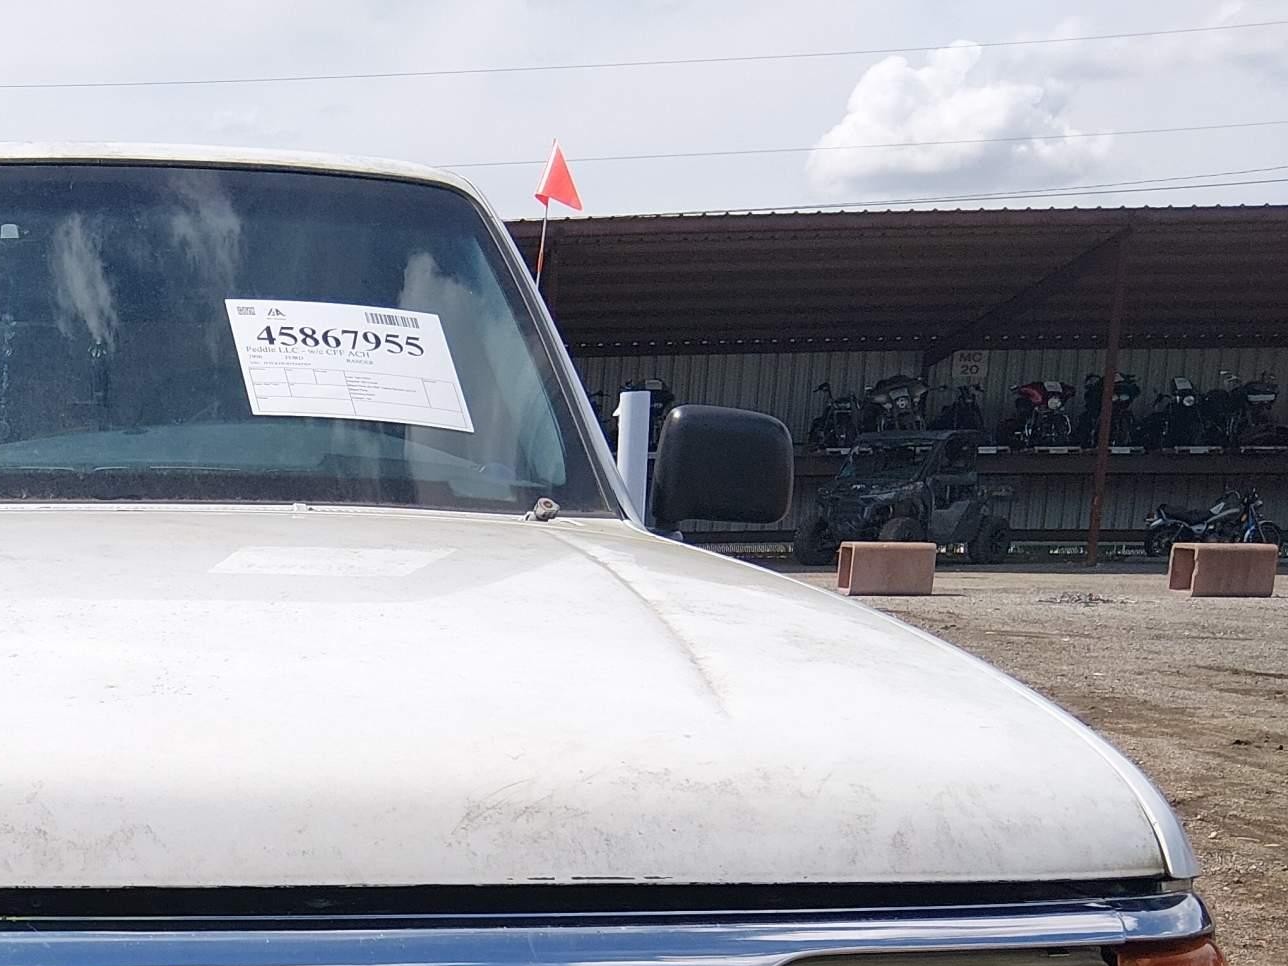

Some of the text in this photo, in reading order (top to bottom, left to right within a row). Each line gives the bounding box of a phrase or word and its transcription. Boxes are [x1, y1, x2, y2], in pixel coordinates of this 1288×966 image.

[256, 324, 425, 357] 45867955
[246, 345, 276, 353] Peddle
[278, 346, 298, 354] LLC
[959, 352, 983, 362] MC
[959, 364, 980, 375] 20
